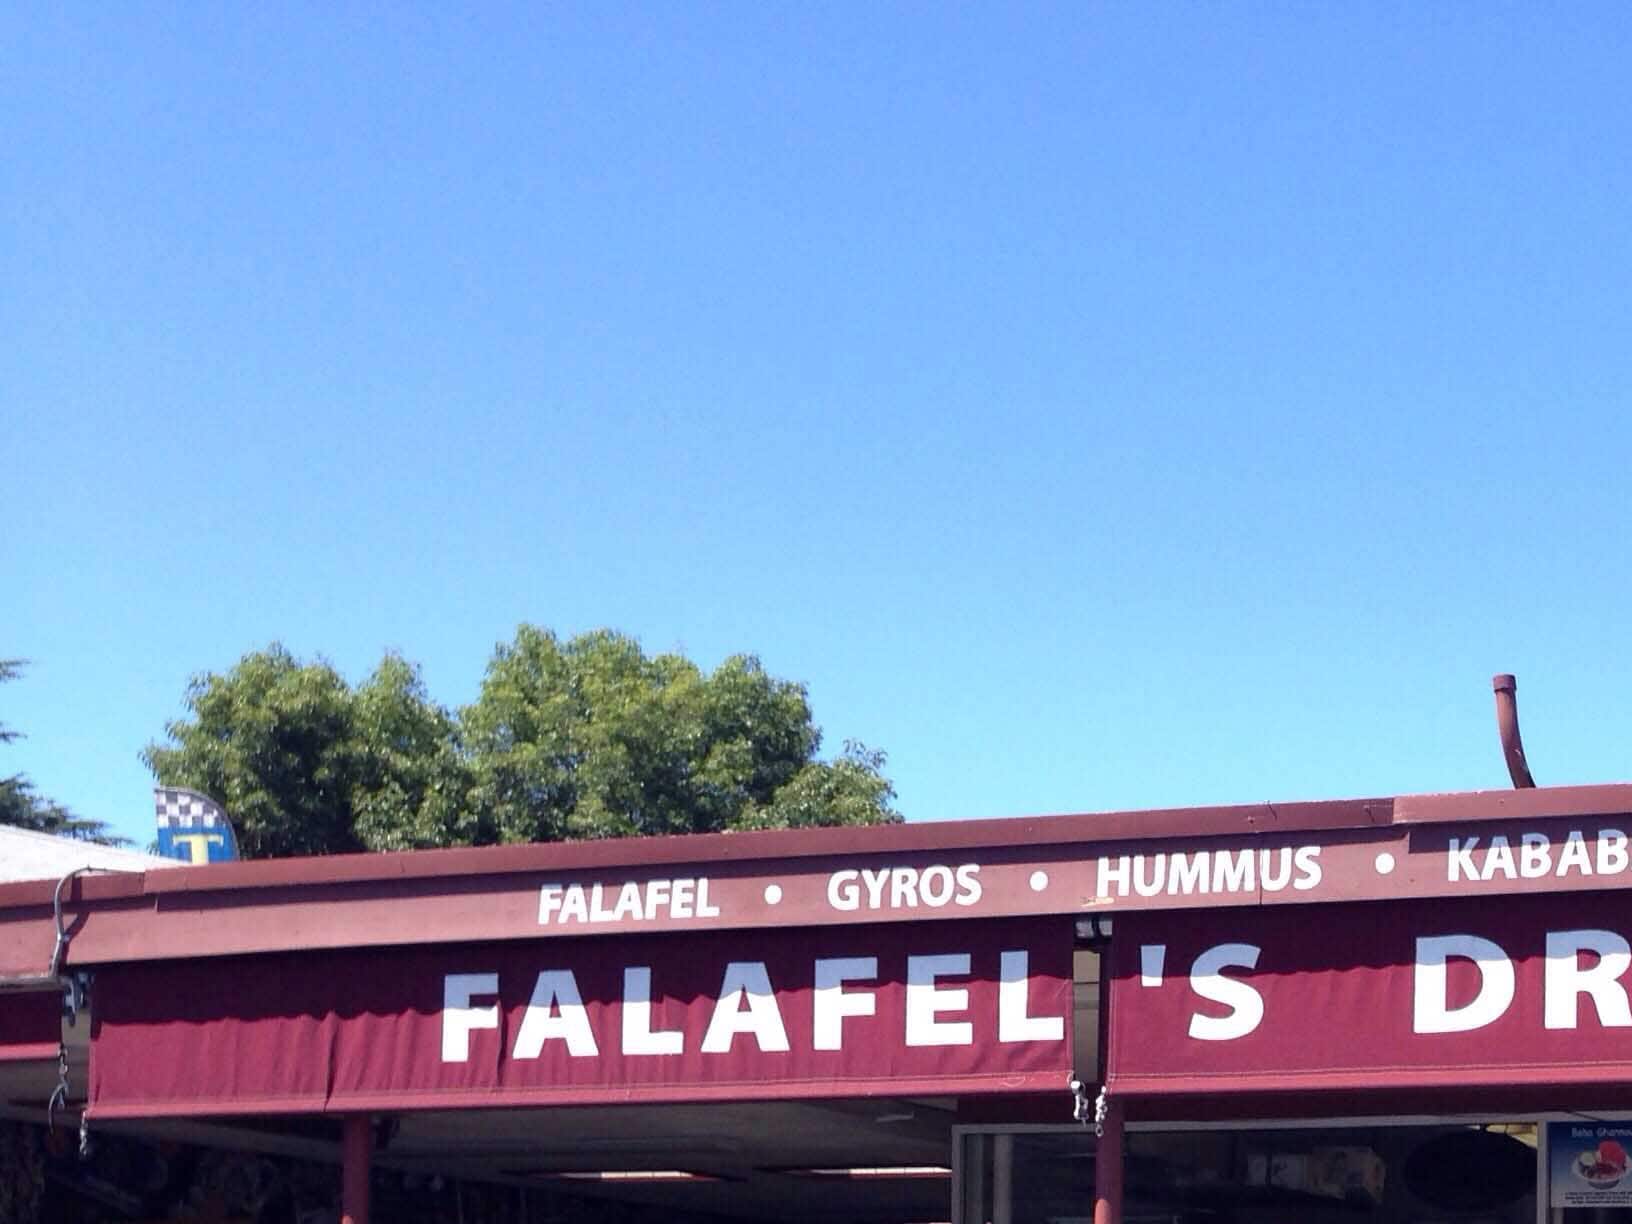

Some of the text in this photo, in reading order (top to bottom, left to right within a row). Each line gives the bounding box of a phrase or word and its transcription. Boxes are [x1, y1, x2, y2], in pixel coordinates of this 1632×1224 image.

[538, 877, 721, 926] FALAFEL
[827, 863, 983, 912] GYROS
[1098, 845, 1322, 898] HUMMUS
